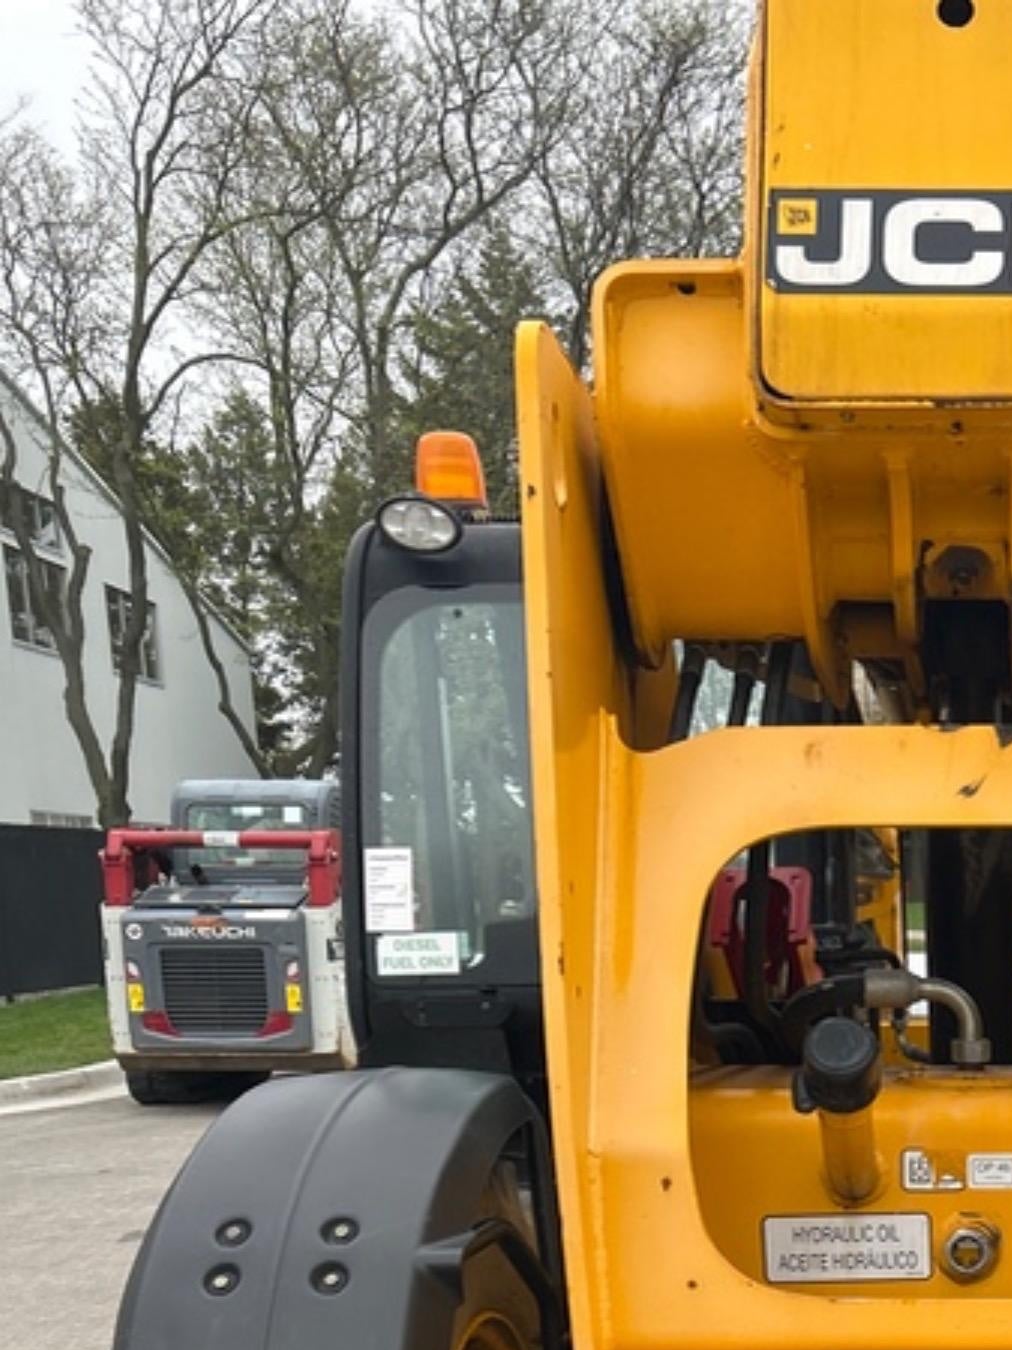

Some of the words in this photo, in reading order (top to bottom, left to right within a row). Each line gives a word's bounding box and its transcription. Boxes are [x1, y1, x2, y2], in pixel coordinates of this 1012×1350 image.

[392, 938, 441, 952] DIESEL
[382, 956, 416, 969] FUEL
[419, 956, 454, 969] ONLY
[791, 1223, 872, 1244] HYDRAULIC
[876, 1223, 901, 1243] OIL
[778, 1251, 829, 1273] ACEITE
[832, 1248, 919, 1272] HIDRÁULICO
